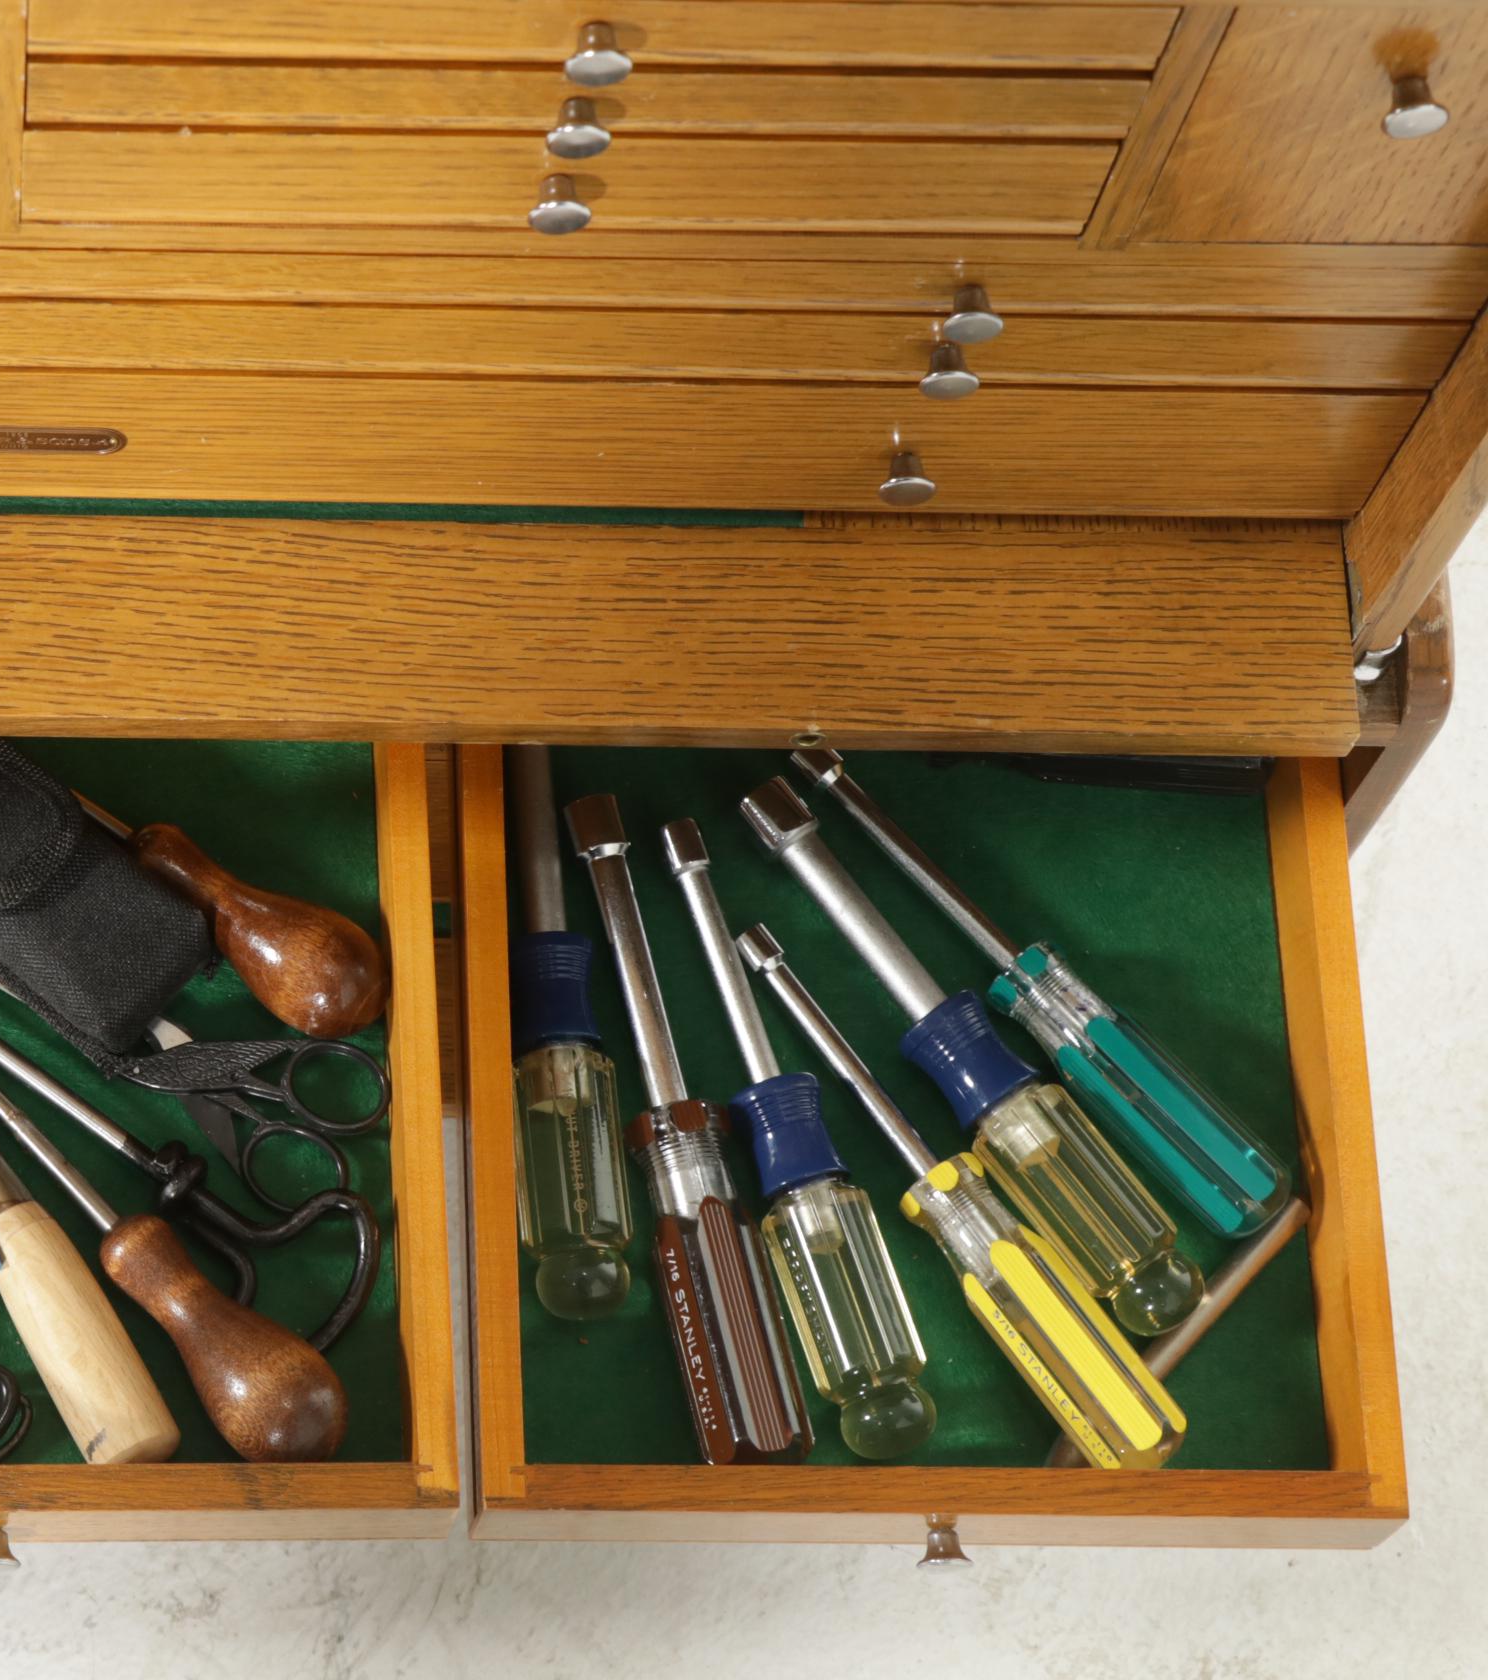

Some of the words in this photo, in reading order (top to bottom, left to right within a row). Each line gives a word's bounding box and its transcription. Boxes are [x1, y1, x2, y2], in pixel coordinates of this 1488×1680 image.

[663, 1248, 681, 1283] 7/16
[675, 1288, 707, 1381] STANLEY
[1018, 1342, 1080, 1422] STANLEY
